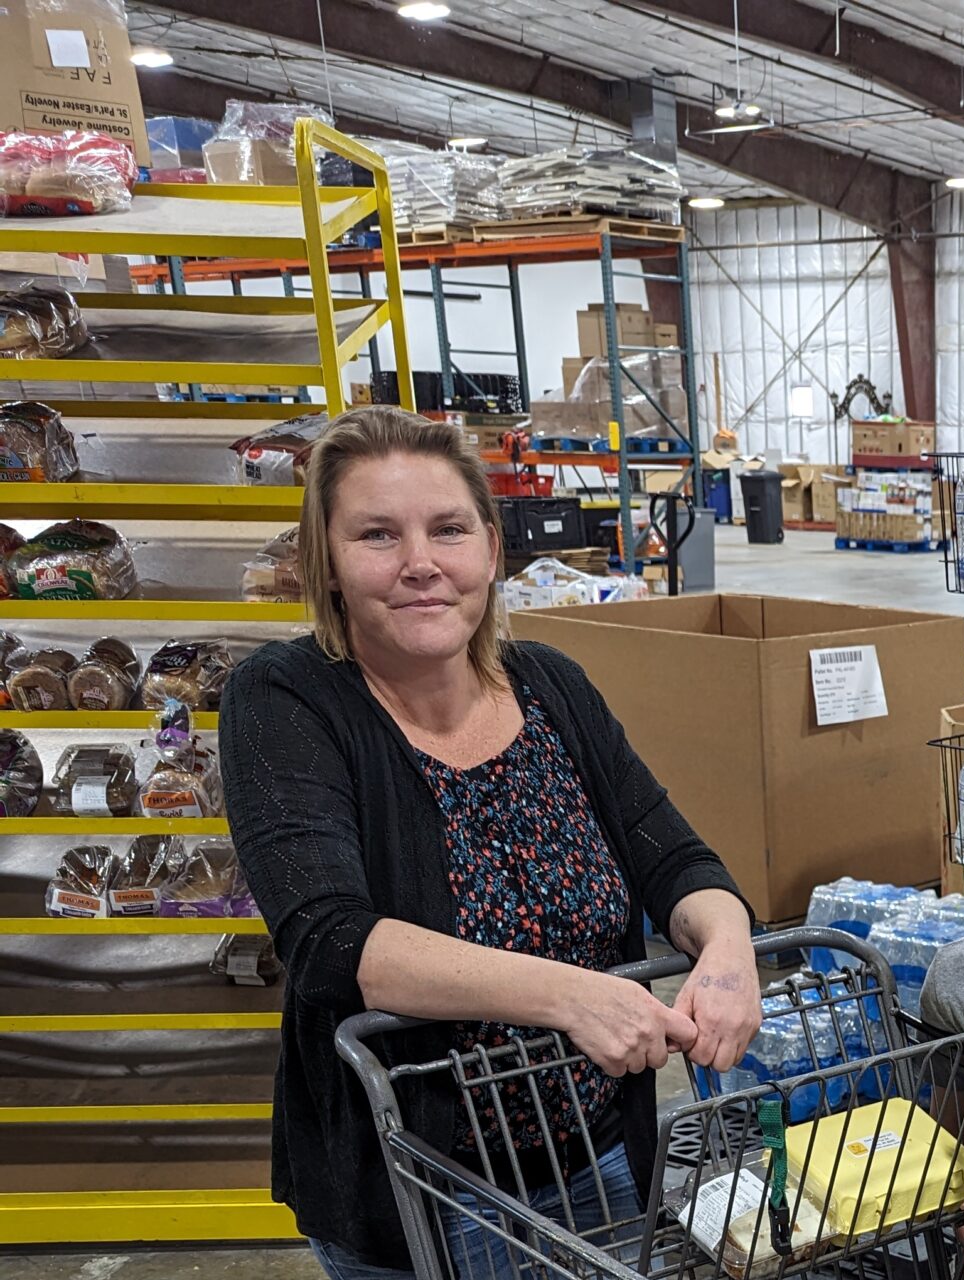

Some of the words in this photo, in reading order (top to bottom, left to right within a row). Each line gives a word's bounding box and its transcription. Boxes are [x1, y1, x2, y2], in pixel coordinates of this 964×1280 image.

[24, 93, 60, 110] Novelty
[41, 114, 83, 130] Jewelry
[86, 121, 130, 136] Costume
